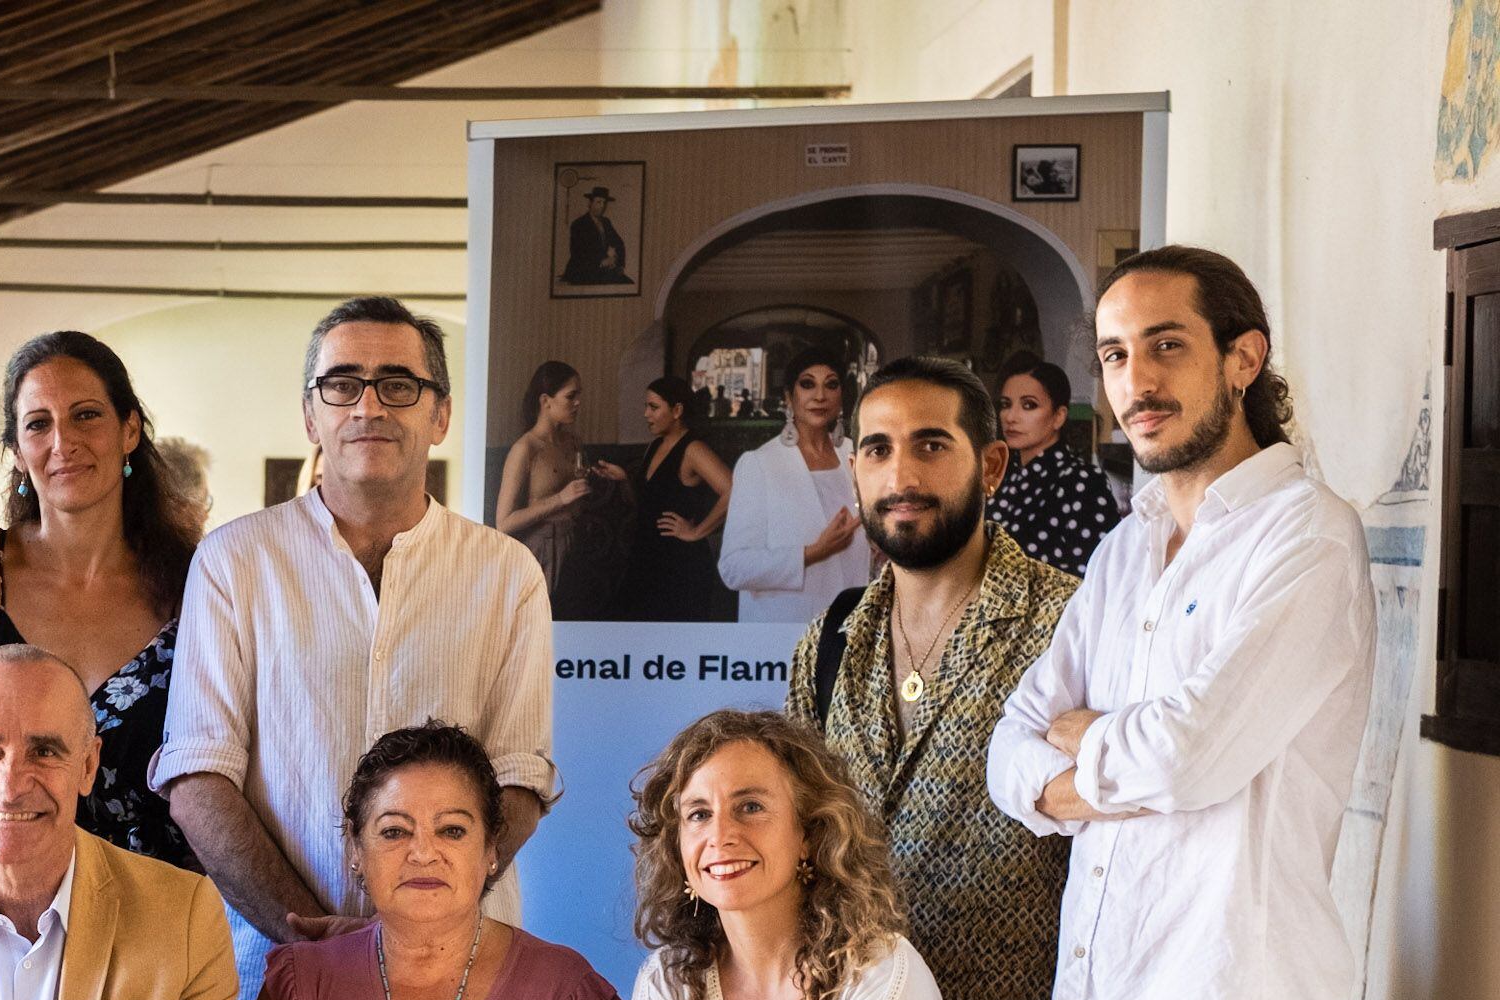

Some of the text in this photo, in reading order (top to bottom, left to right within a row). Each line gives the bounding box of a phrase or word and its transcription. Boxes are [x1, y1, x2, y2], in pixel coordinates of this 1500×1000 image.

[555, 654, 787, 681] enal de Flam
